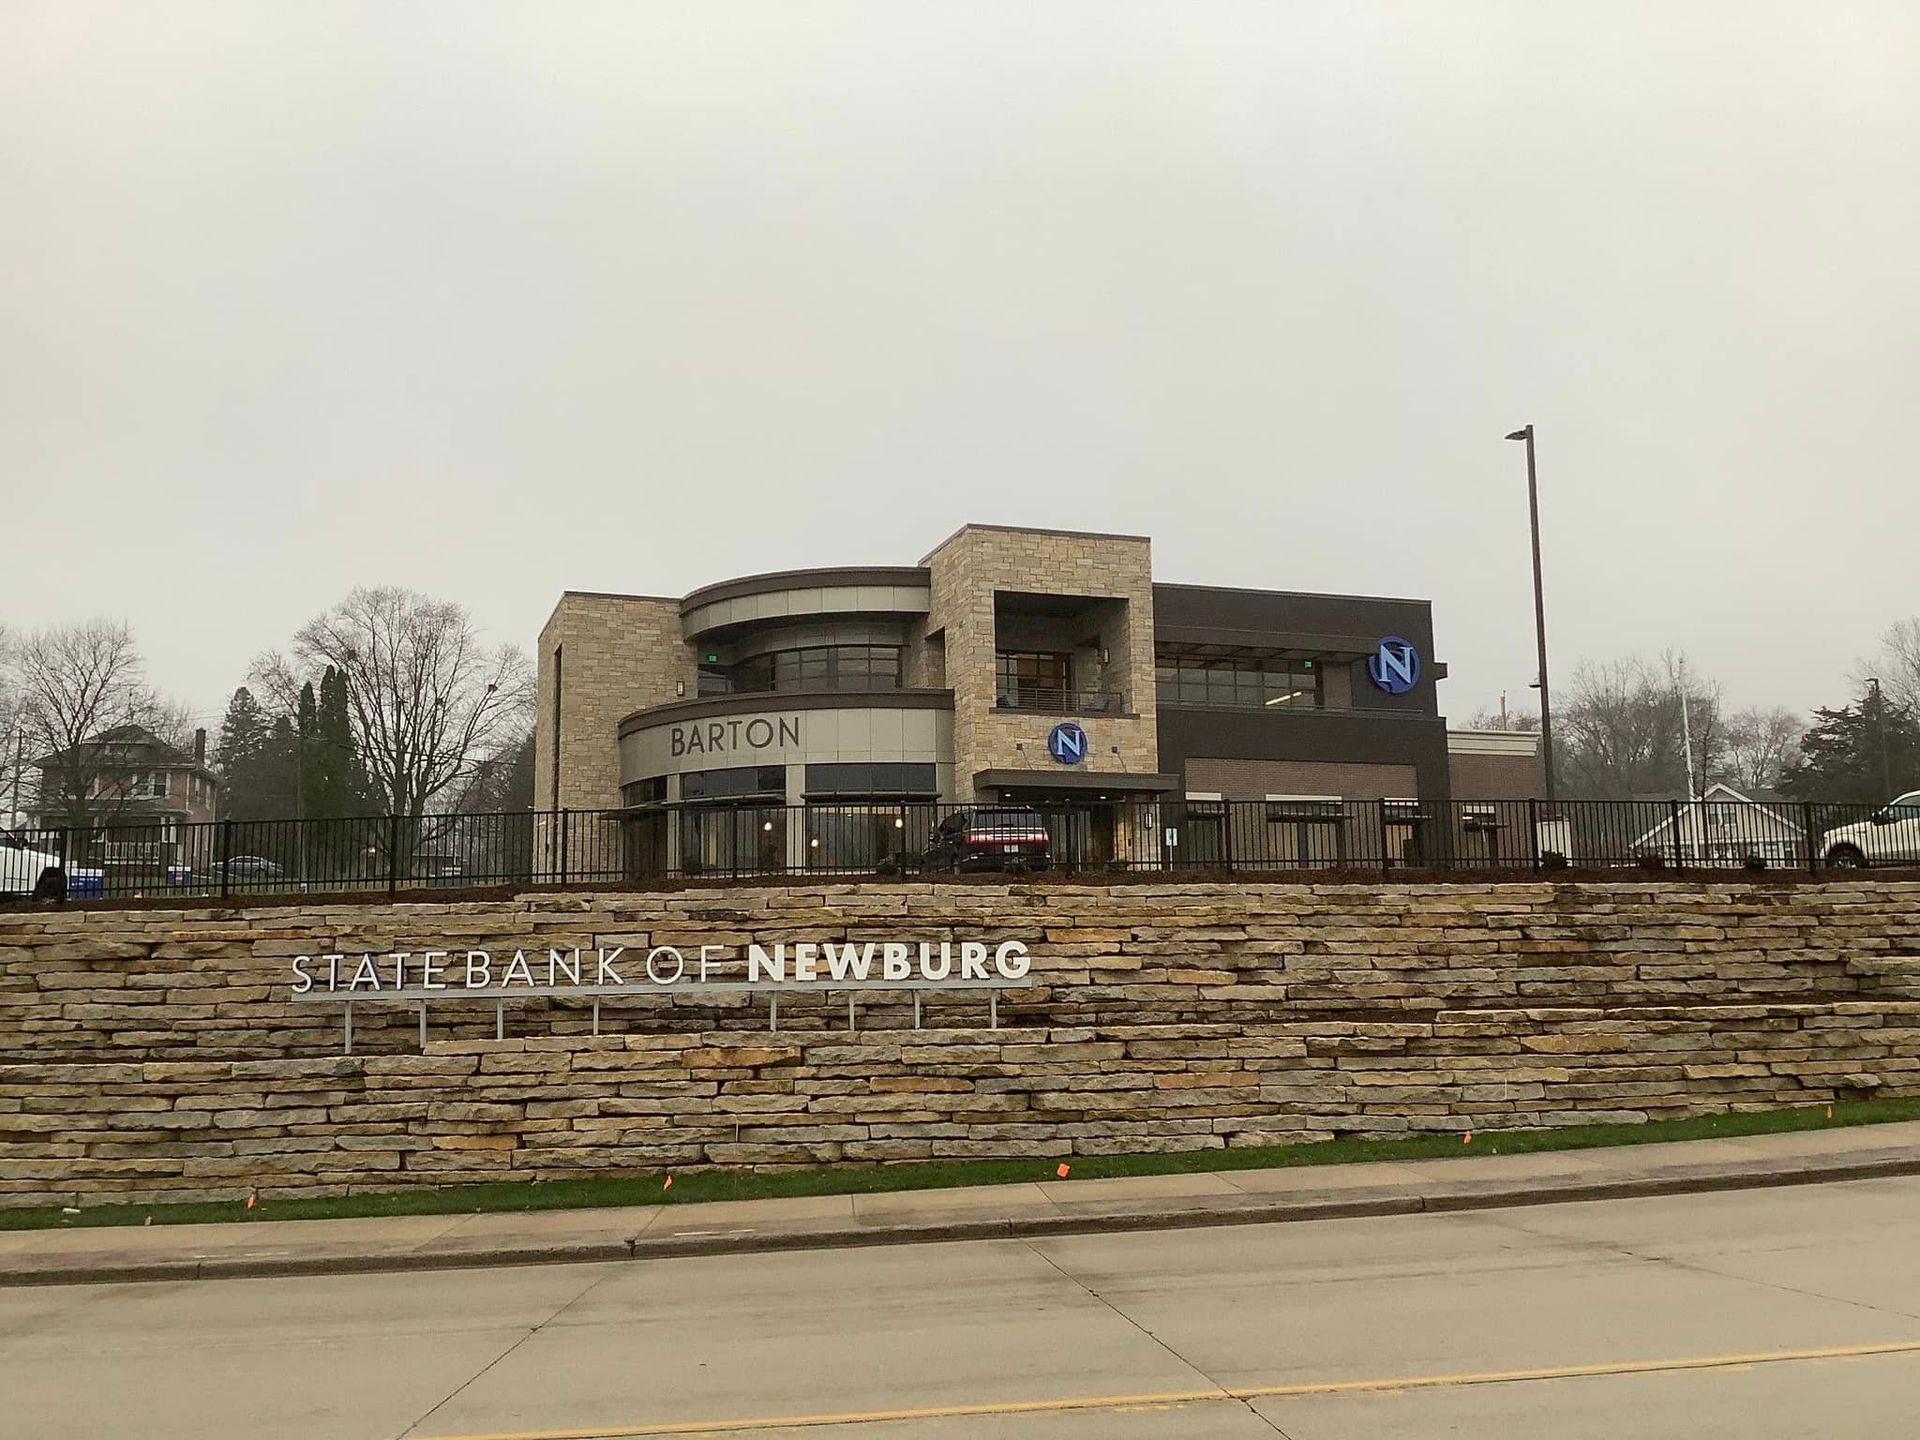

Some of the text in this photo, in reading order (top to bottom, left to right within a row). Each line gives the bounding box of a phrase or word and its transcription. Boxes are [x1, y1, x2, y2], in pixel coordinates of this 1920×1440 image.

[1379, 644, 1414, 684] N
[671, 716, 799, 757] BARTON
[1056, 729, 1081, 756] N
[291, 940, 1032, 993] STATE BANK OF NEWBURG
